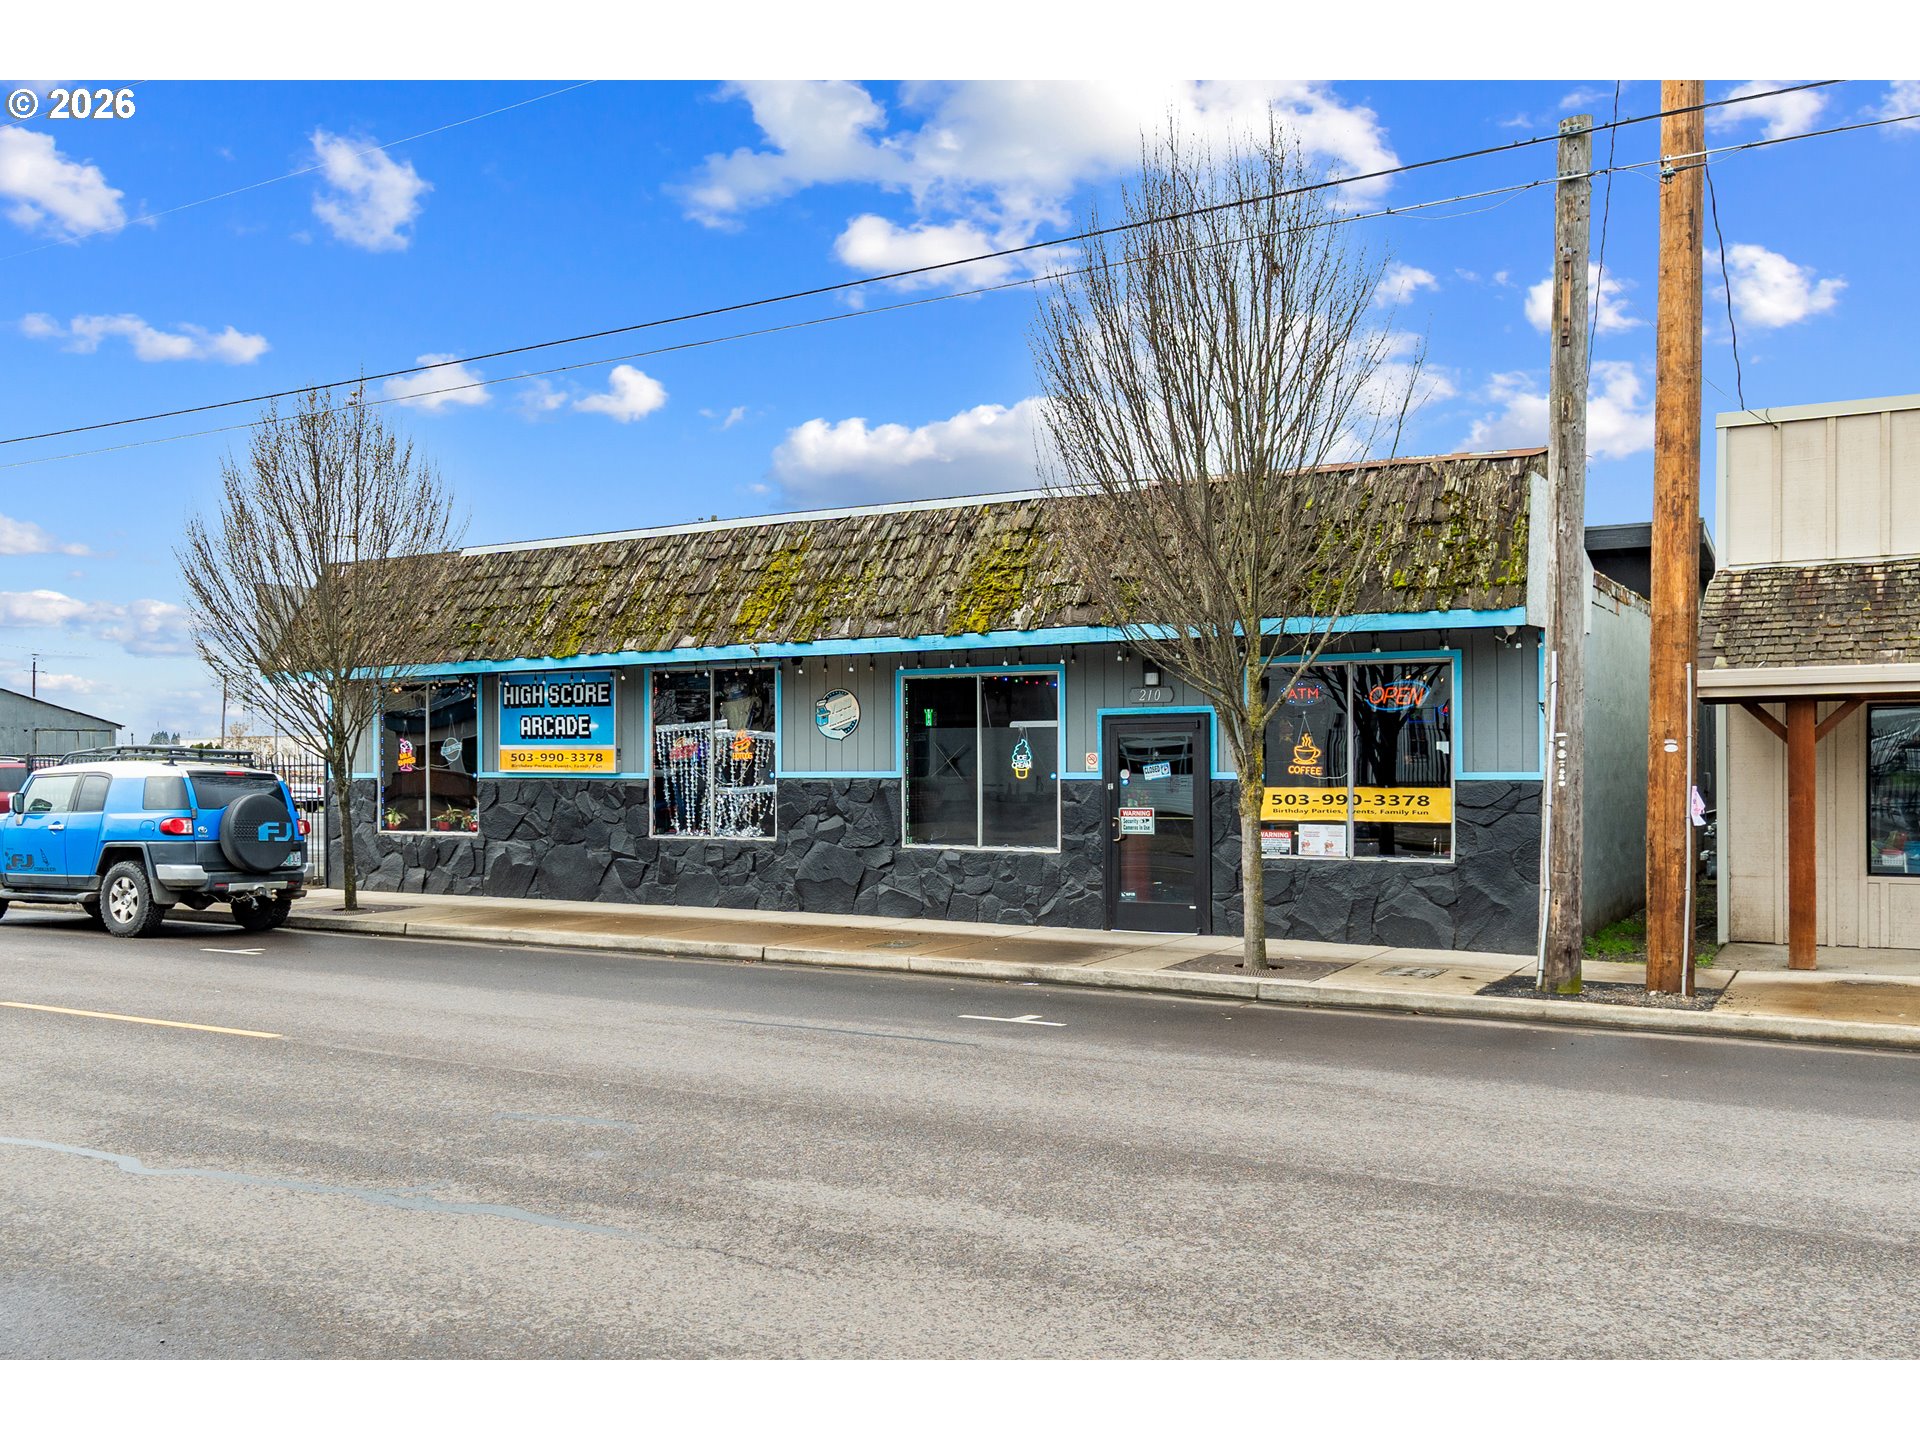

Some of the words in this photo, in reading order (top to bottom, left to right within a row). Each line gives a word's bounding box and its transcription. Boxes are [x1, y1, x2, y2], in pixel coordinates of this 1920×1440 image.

[503, 685, 543, 706] HIGH
[548, 683, 610, 705] SCORE
[1139, 689, 1161, 701] 210
[1287, 687, 1319, 700] ATM
[1369, 686, 1424, 705] OPEN
[520, 716, 590, 736] ARCADE
[510, 752, 604, 763] 503-990-3378
[1144, 766, 1160, 774] CLOSED
[1288, 765, 1323, 776] COFFEE
[1271, 794, 1430, 807] 503-990-3378
[258, 822, 292, 842] FJ
